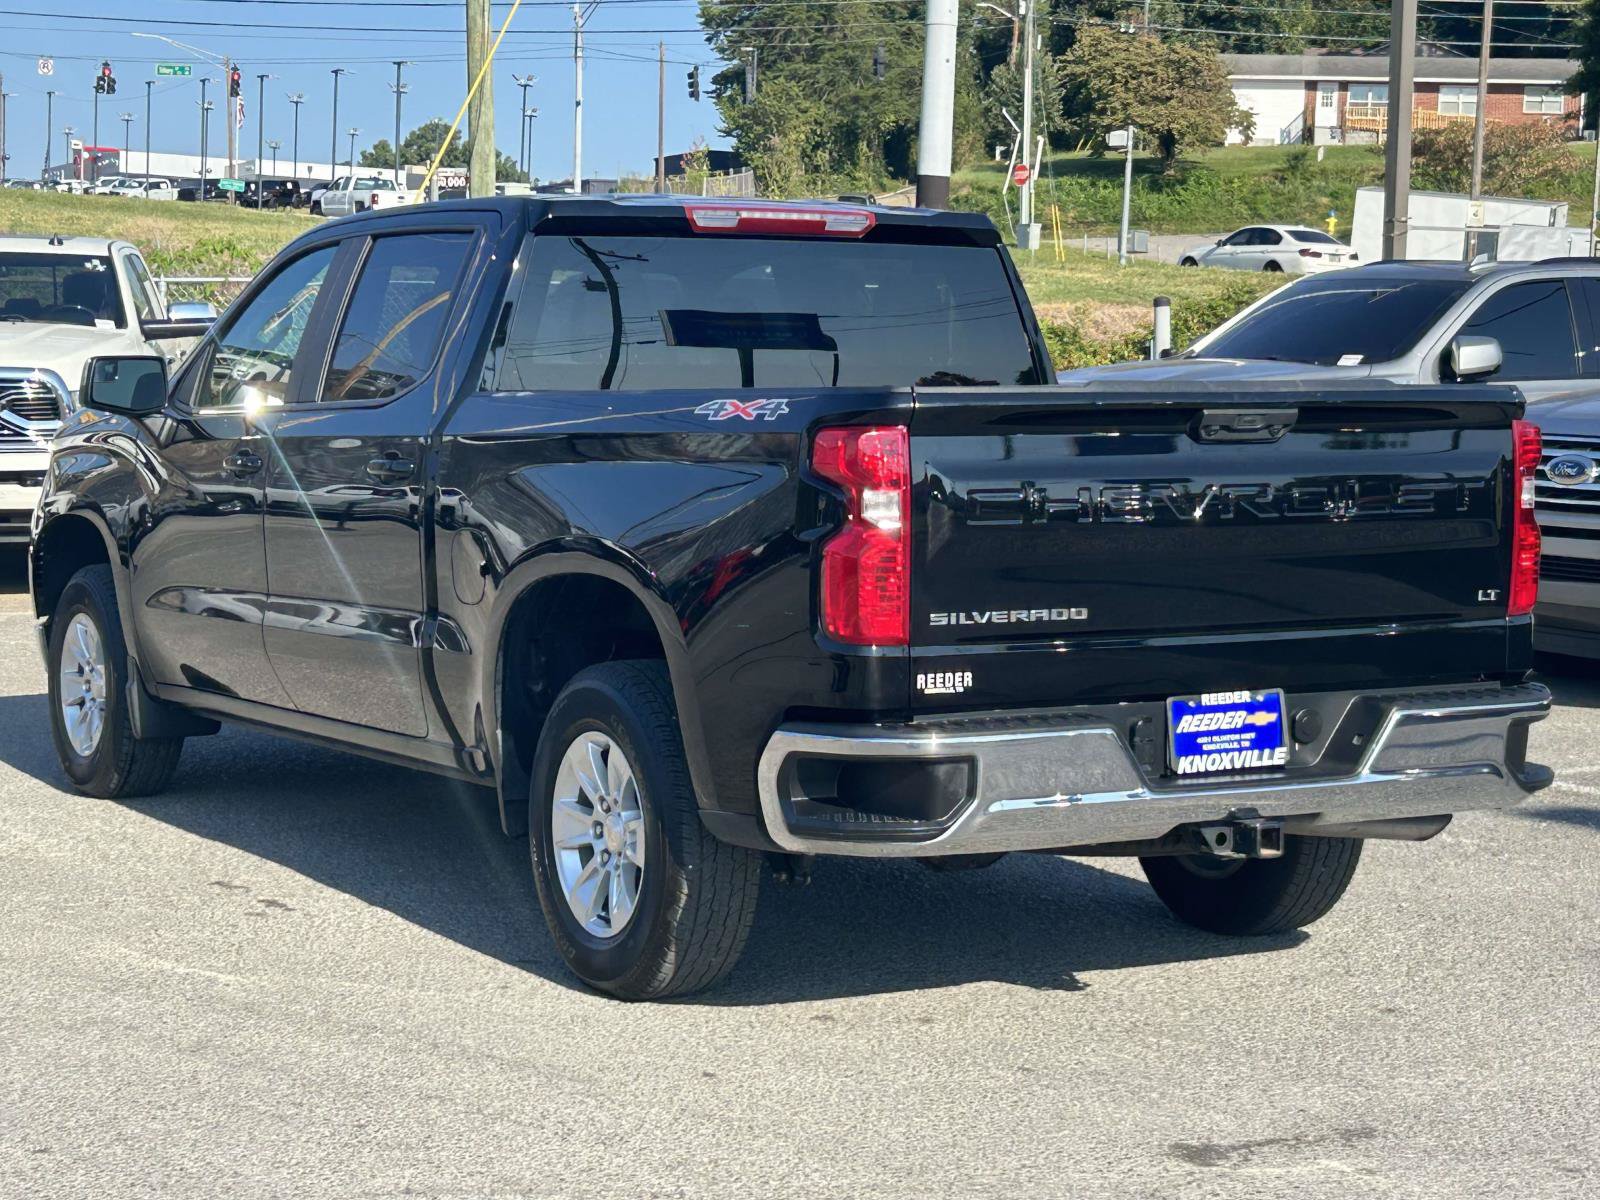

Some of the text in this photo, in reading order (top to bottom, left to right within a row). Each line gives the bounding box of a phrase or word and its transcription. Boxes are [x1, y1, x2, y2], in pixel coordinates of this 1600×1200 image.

[1555, 462, 1578, 476] Ford
[966, 480, 1486, 526] CHEVROLET
[1478, 589, 1500, 601] LT
[929, 607, 1088, 626] SILVERADO
[916, 671, 973, 689] REEDER
[1201, 690, 1252, 706] REEDER
[1176, 710, 1247, 733] REEDER
[1177, 747, 1288, 774] KNOXVILLE
